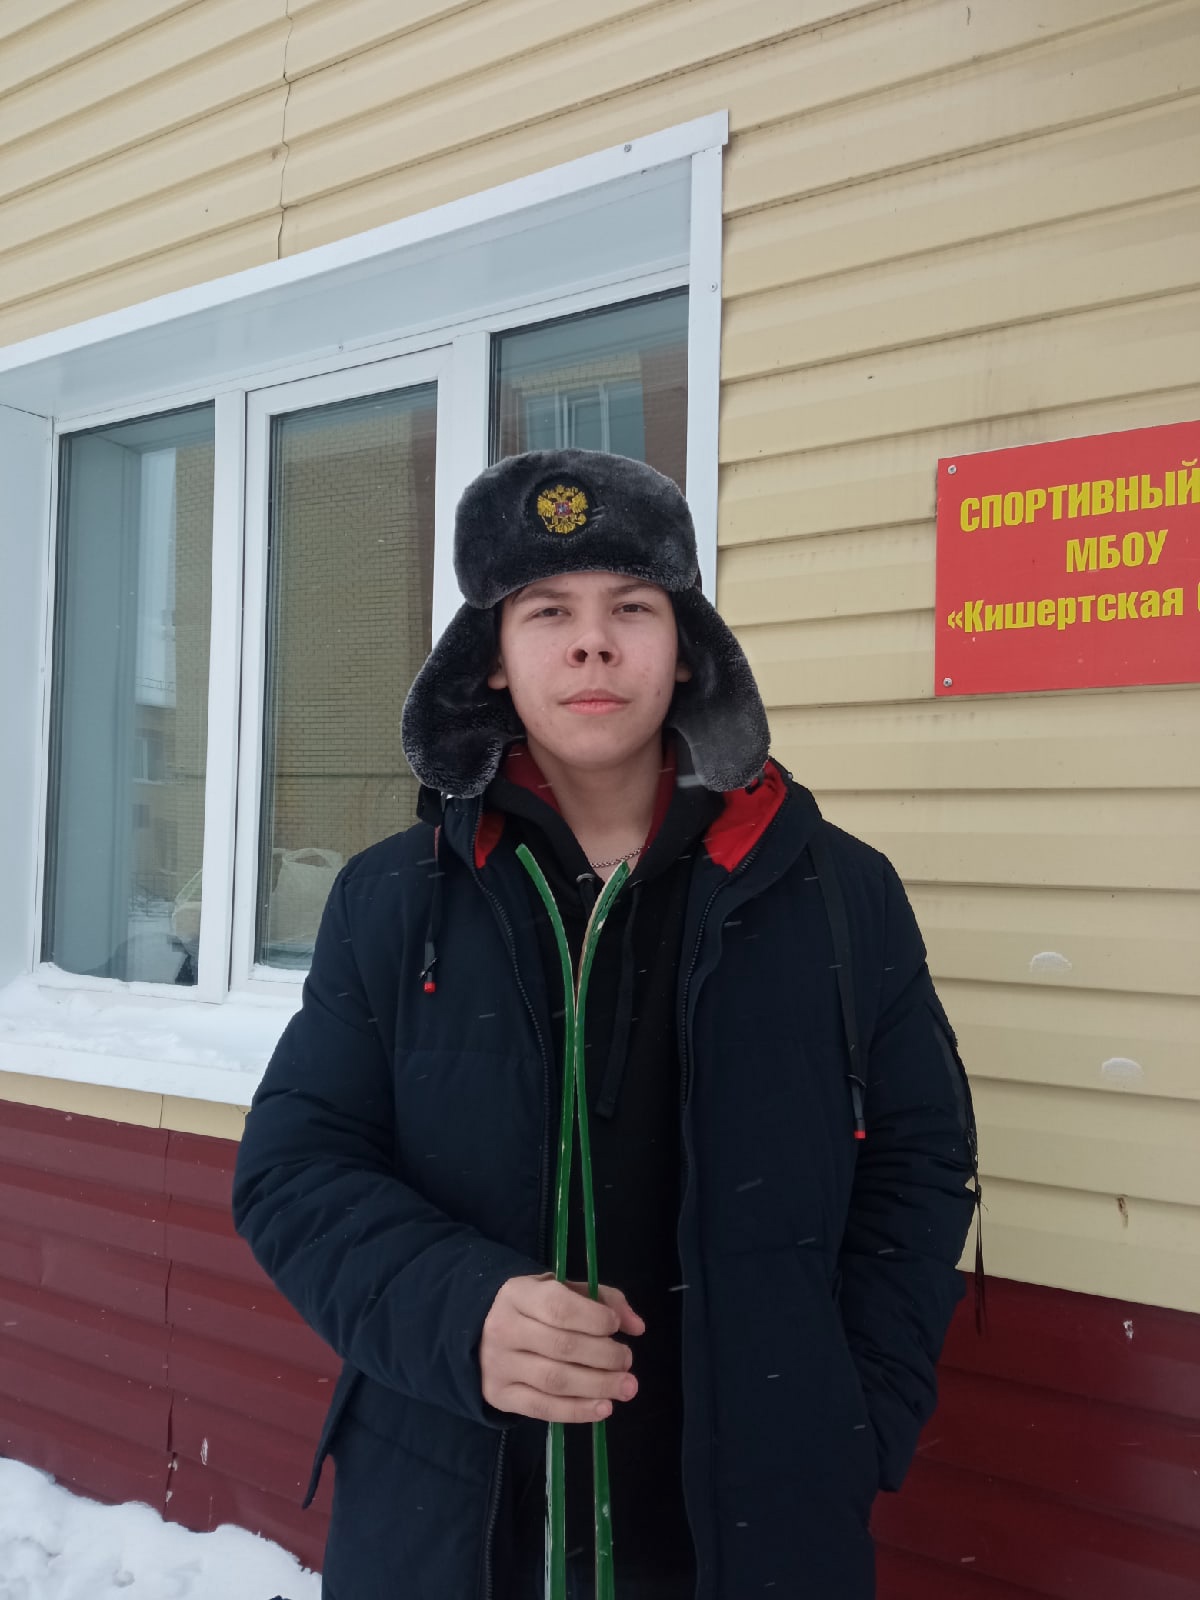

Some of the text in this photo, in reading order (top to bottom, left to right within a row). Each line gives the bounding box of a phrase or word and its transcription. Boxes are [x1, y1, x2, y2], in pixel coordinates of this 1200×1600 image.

[960, 458, 1200, 532] СПОРТИВНЫЙ
[1066, 529, 1168, 573] МБОУ
[947, 587, 1184, 633] «Кишертская
